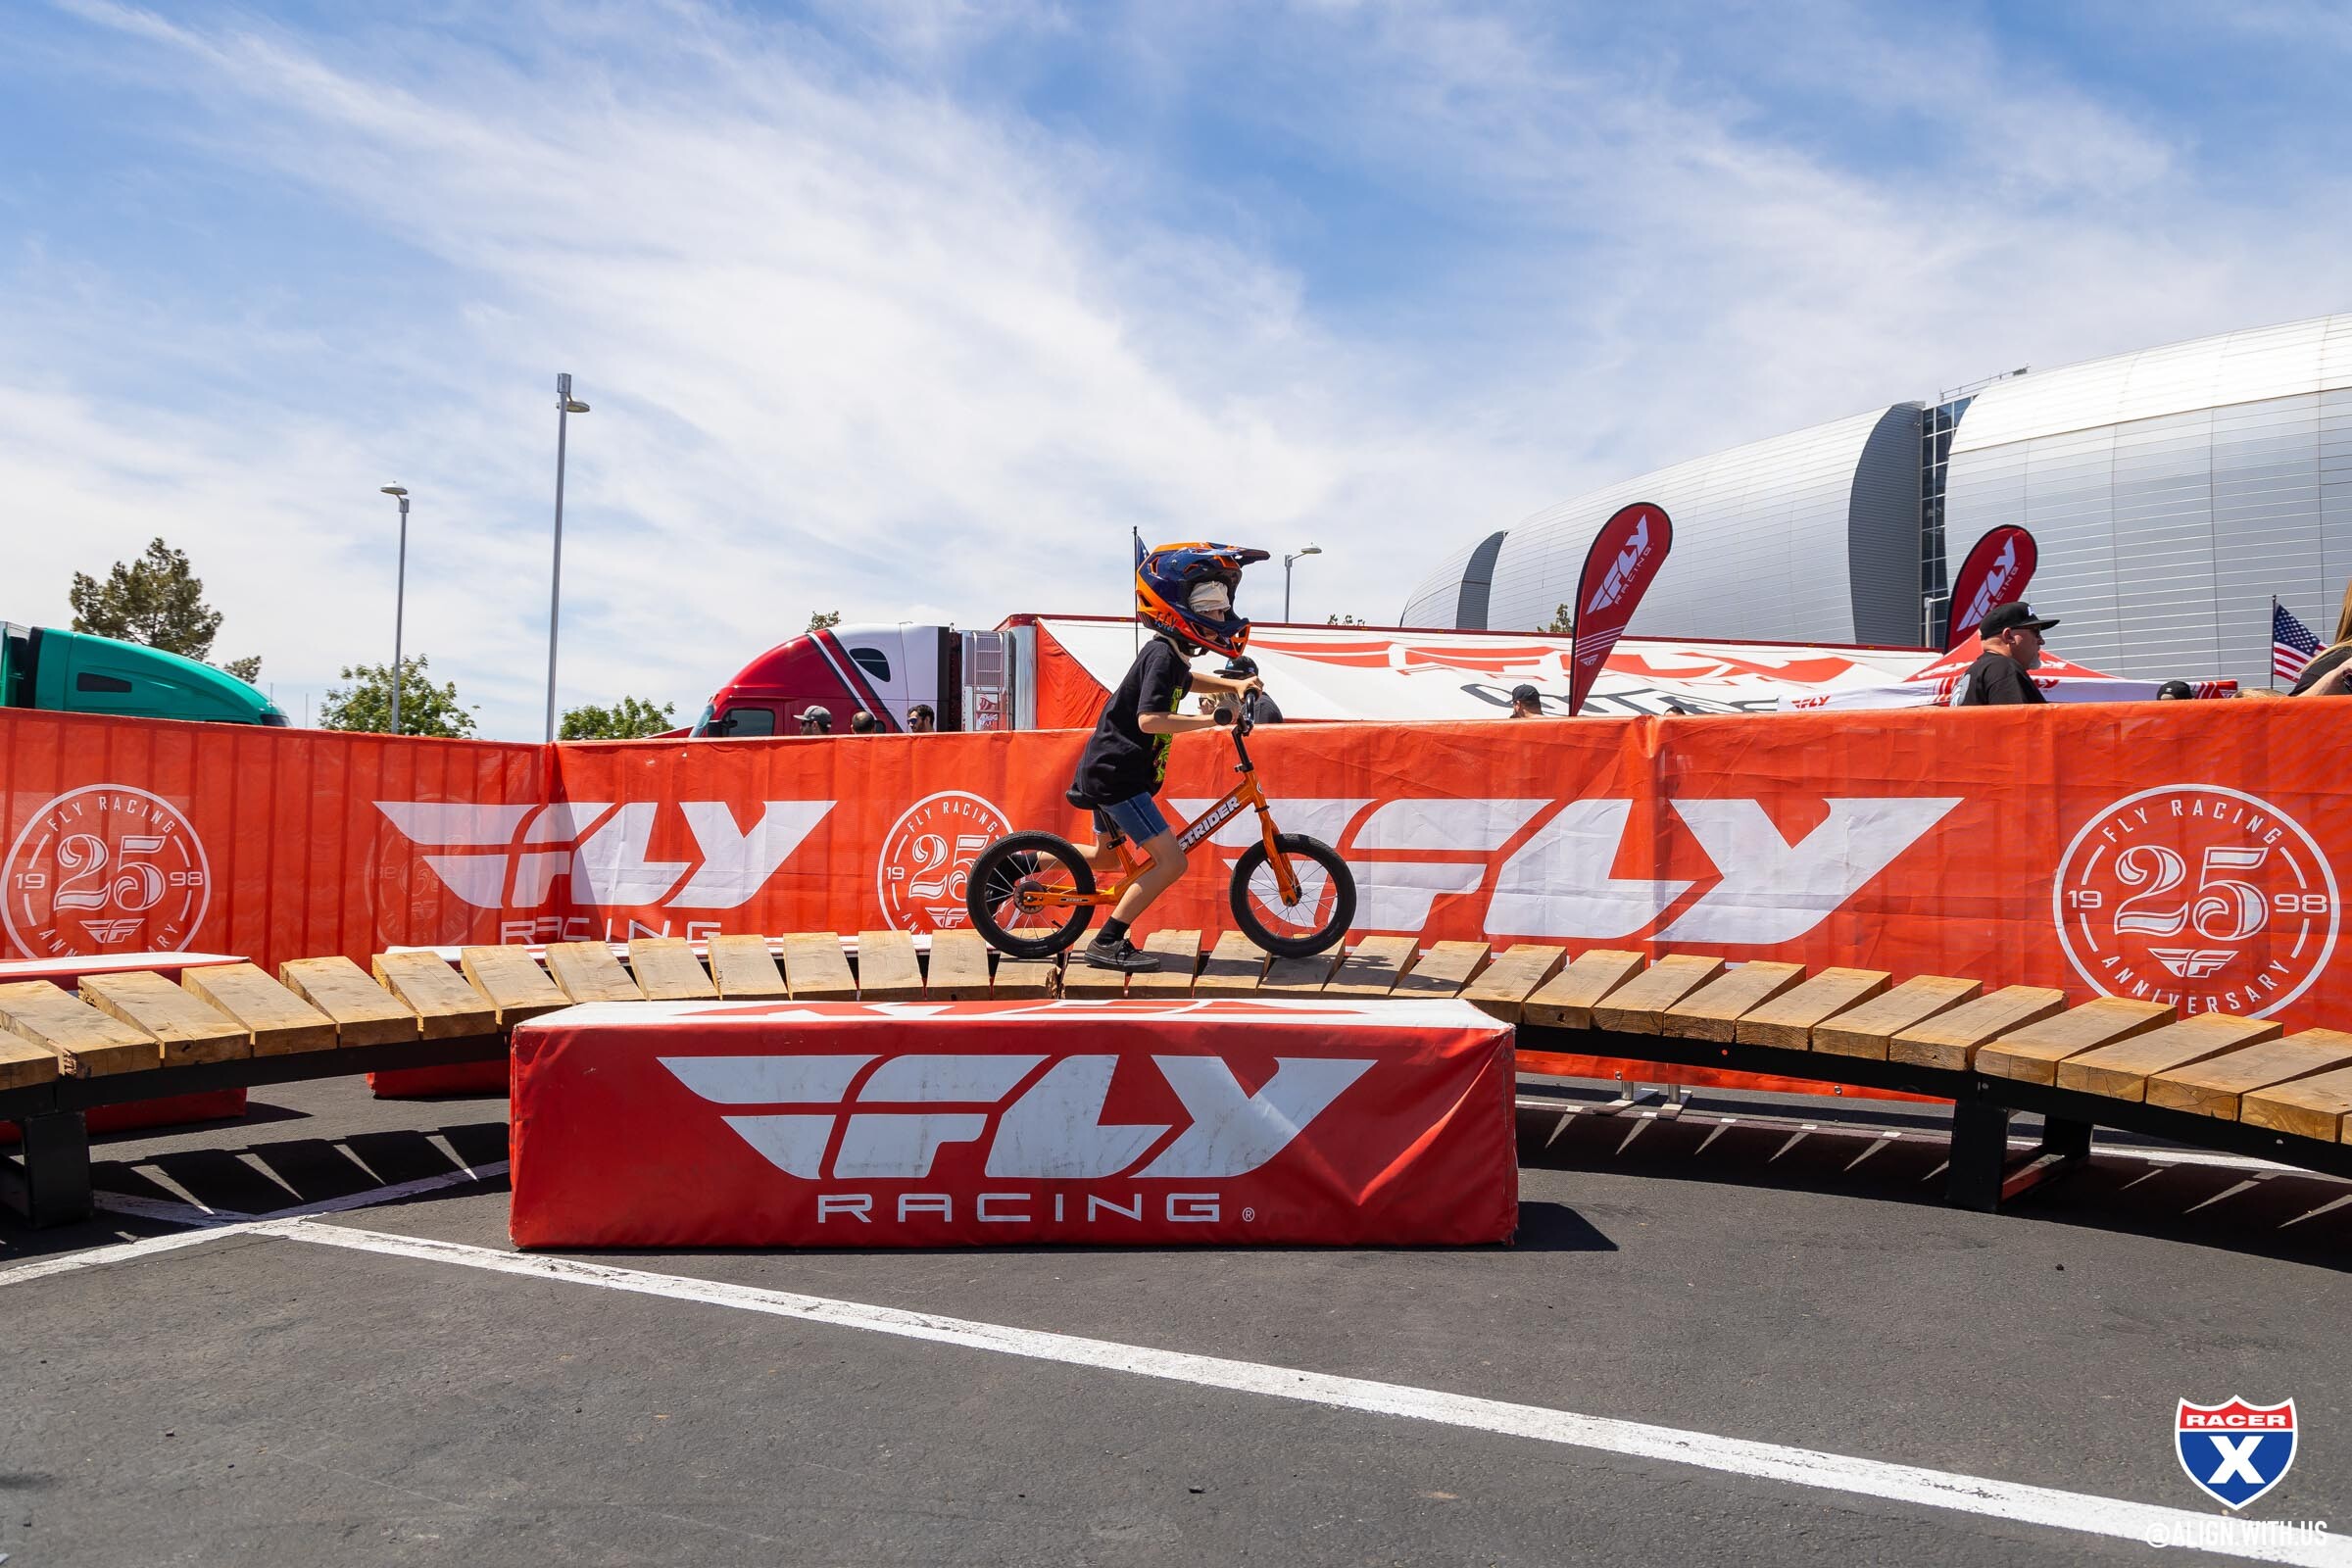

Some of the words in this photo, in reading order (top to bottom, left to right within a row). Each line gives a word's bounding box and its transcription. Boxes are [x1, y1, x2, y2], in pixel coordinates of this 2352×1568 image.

[1586, 514, 1649, 614] FLY
[1614, 547, 1651, 605] RACING
[1957, 535, 2016, 632] FLY
[1989, 565, 2019, 612] ACING
[1791, 696, 1831, 710] FLY
[47, 802, 82, 832] FLY
[99, 796, 176, 834] RACING
[906, 807, 933, 833] FLY
[943, 801, 998, 833] RACING
[1177, 796, 1241, 851] STRIDER
[2102, 807, 2148, 843] FLY
[2171, 799, 2282, 845] RACING
[16, 873, 46, 890] 19
[170, 871, 204, 887] 98
[54, 833, 166, 911] 25
[372, 800, 838, 909] FLY
[886, 866, 905, 880] 19
[908, 834, 990, 903] 25
[1165, 797, 1964, 944] FLY
[2068, 890, 2102, 908] 19
[2274, 894, 2328, 913] 98
[2114, 845, 2270, 941] 25
[501, 916, 721, 946] RACING
[2101, 956, 2290, 1014] ANNIVERSARY
[657, 1054, 1377, 1179] FLY
[817, 1193, 1220, 1223] RACING
